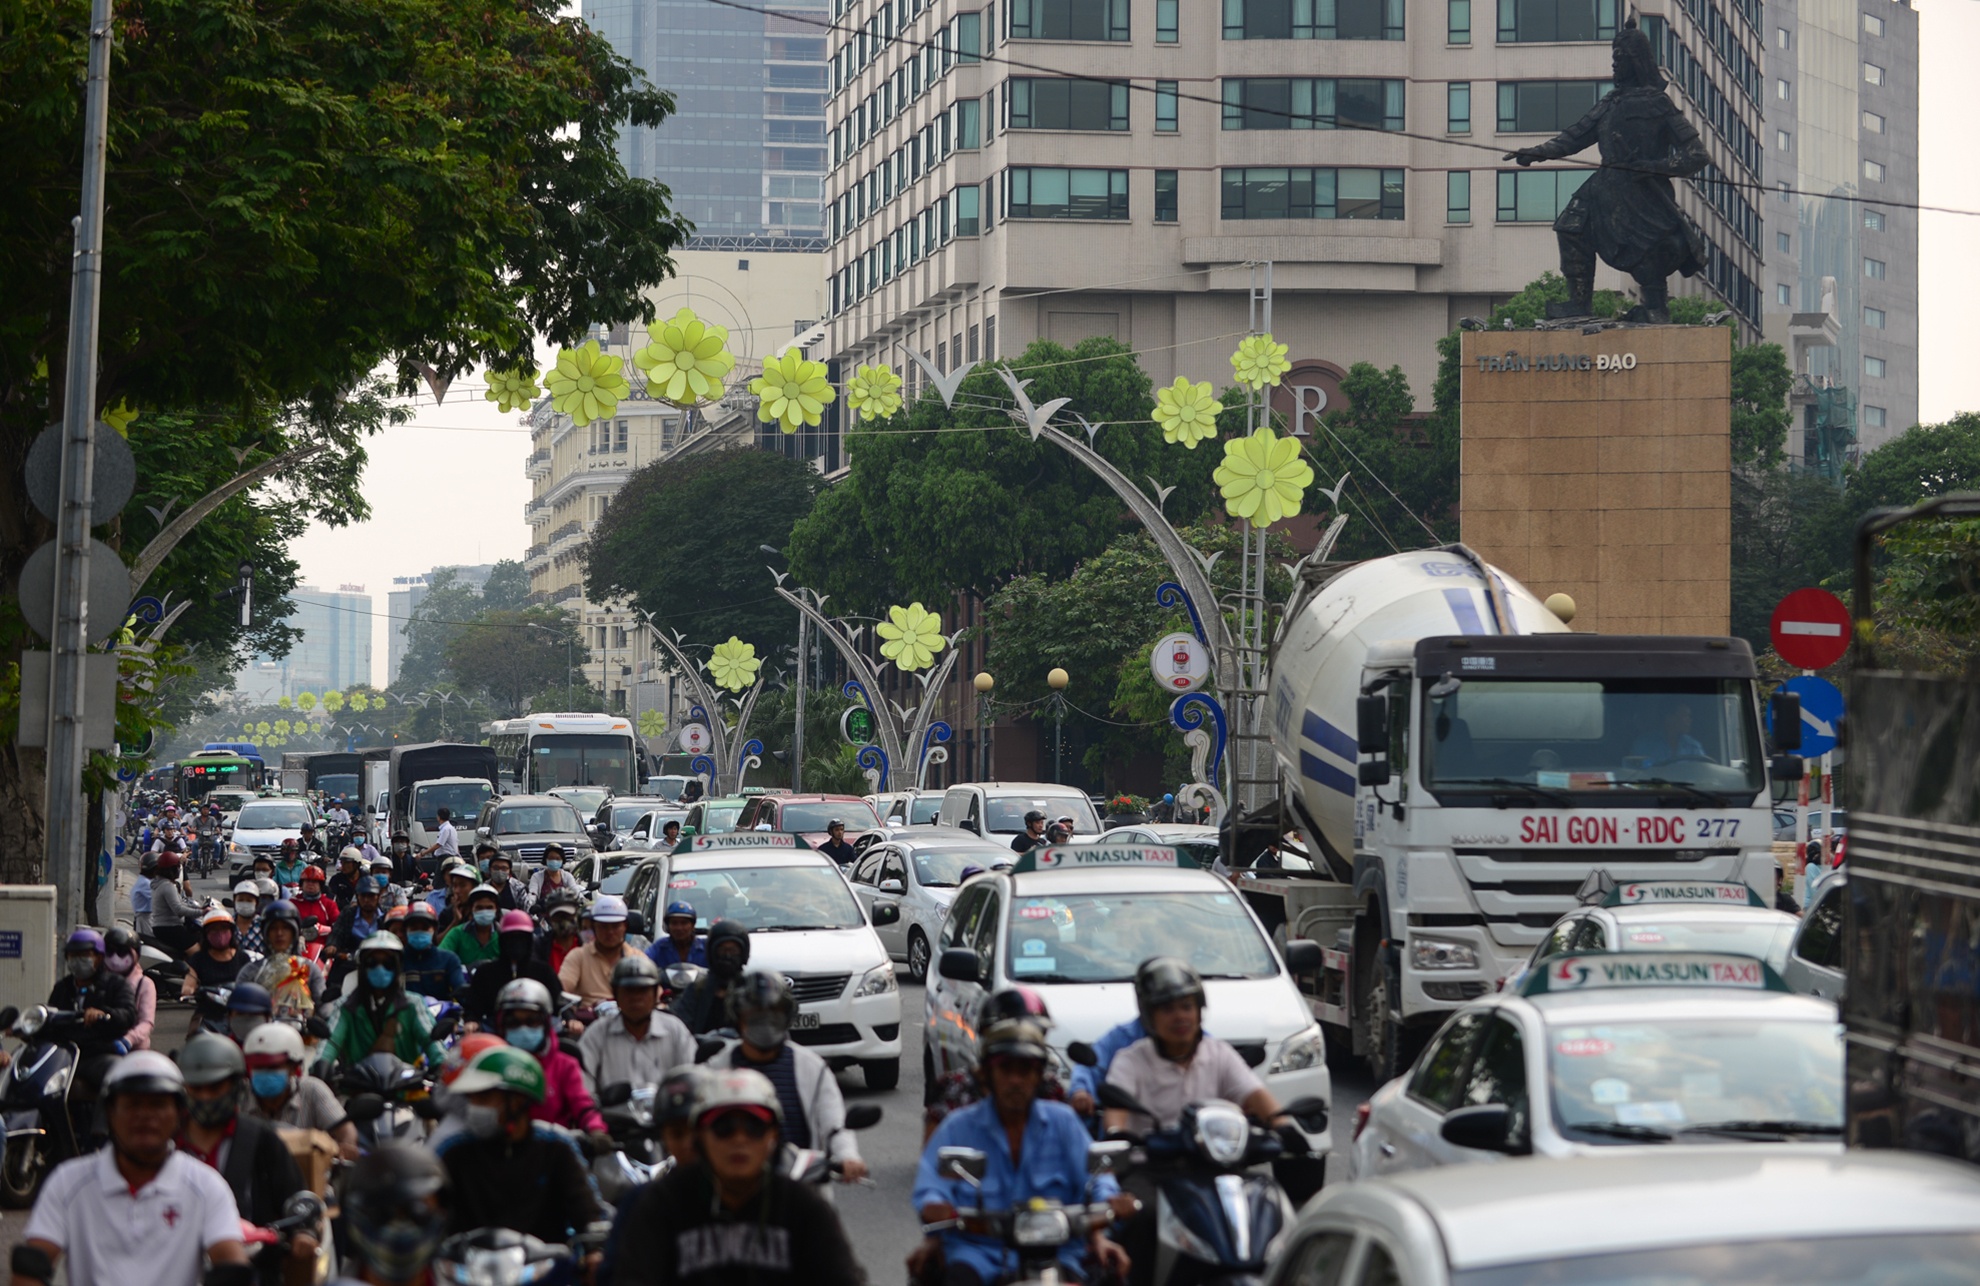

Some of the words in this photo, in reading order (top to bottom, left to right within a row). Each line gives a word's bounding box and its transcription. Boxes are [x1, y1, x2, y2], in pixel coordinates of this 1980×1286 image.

[1596, 353, 1637, 373] ĐẠO
[1291, 385, 1328, 436] R
[1520, 816, 1558, 844] SAI
[1567, 816, 1618, 844] GON
[1637, 816, 1685, 844] RDC
[1697, 818, 1740, 839] 277
